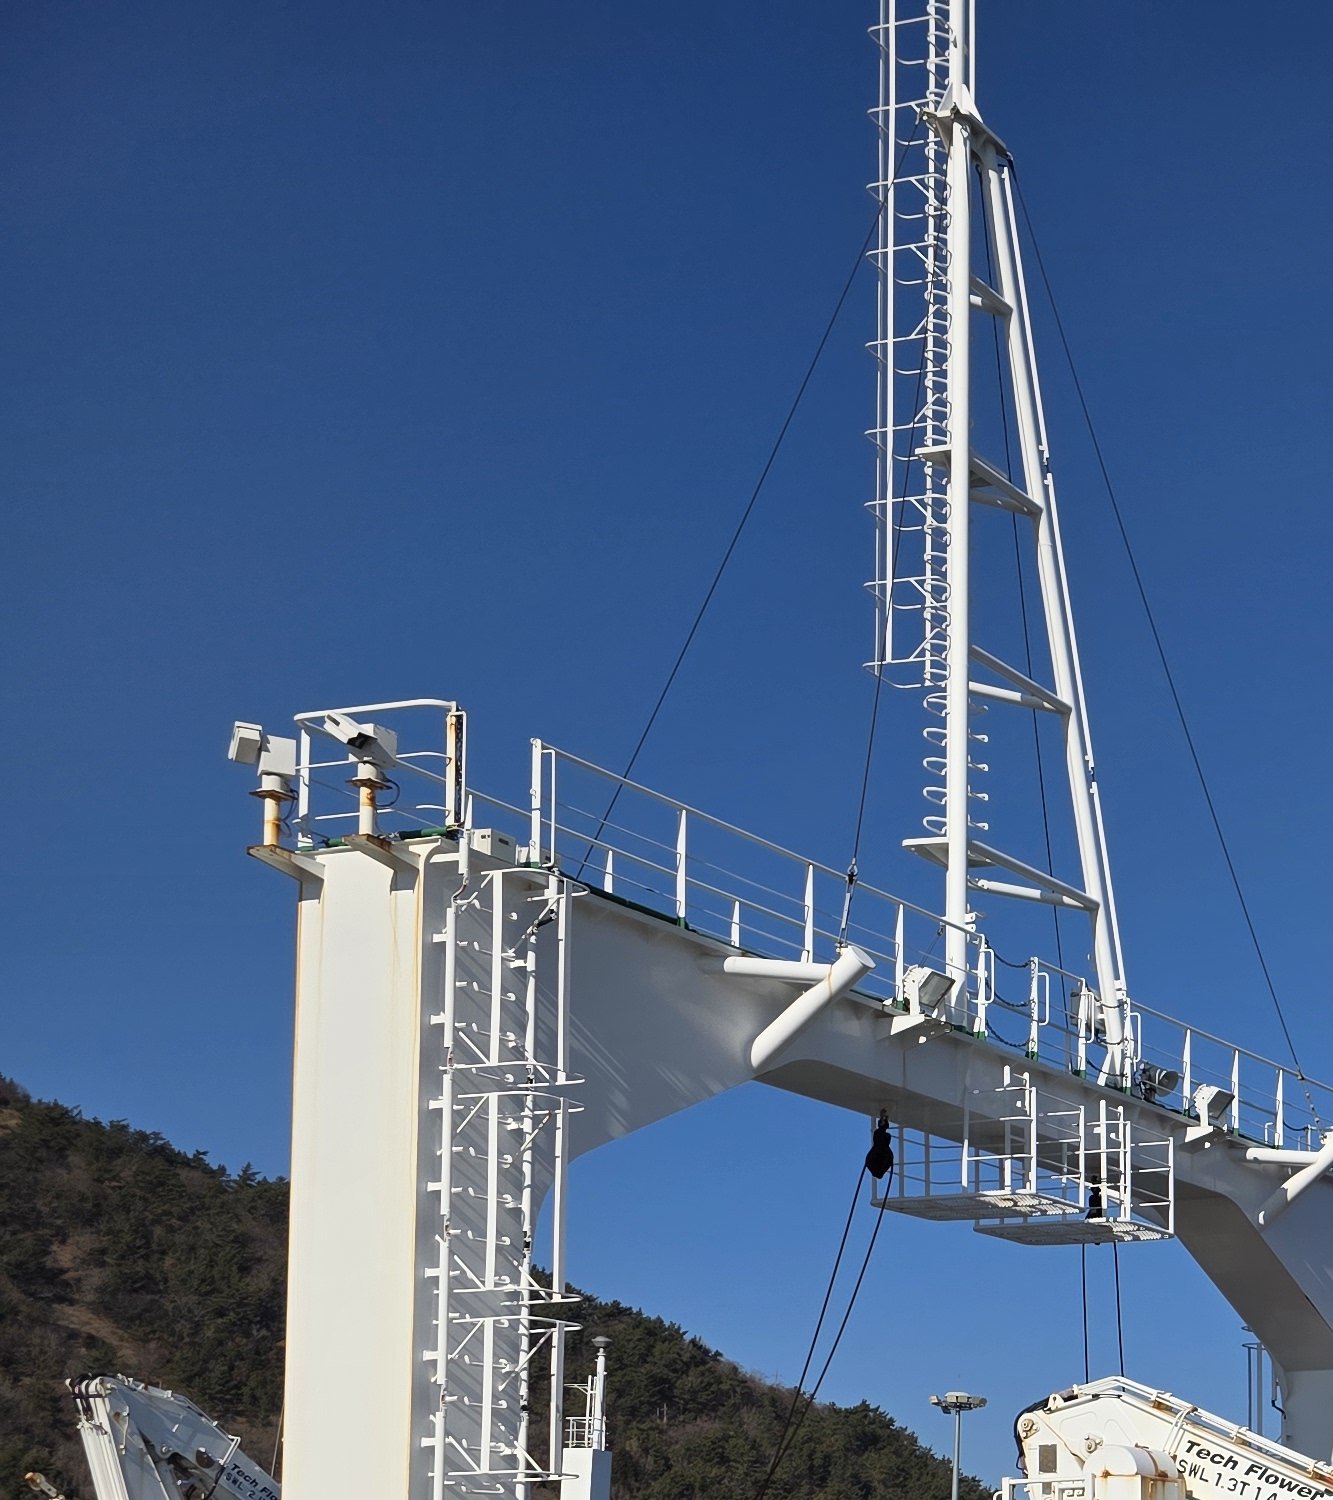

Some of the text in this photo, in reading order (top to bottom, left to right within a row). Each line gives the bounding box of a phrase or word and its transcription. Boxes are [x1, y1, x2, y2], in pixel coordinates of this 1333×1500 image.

[230, 1463, 259, 1488] Tech
[1177, 1459, 1209, 1483] SWL
[1215, 1472, 1250, 1496] 1.3T
[1185, 1440, 1325, 1500] Tech Flower
